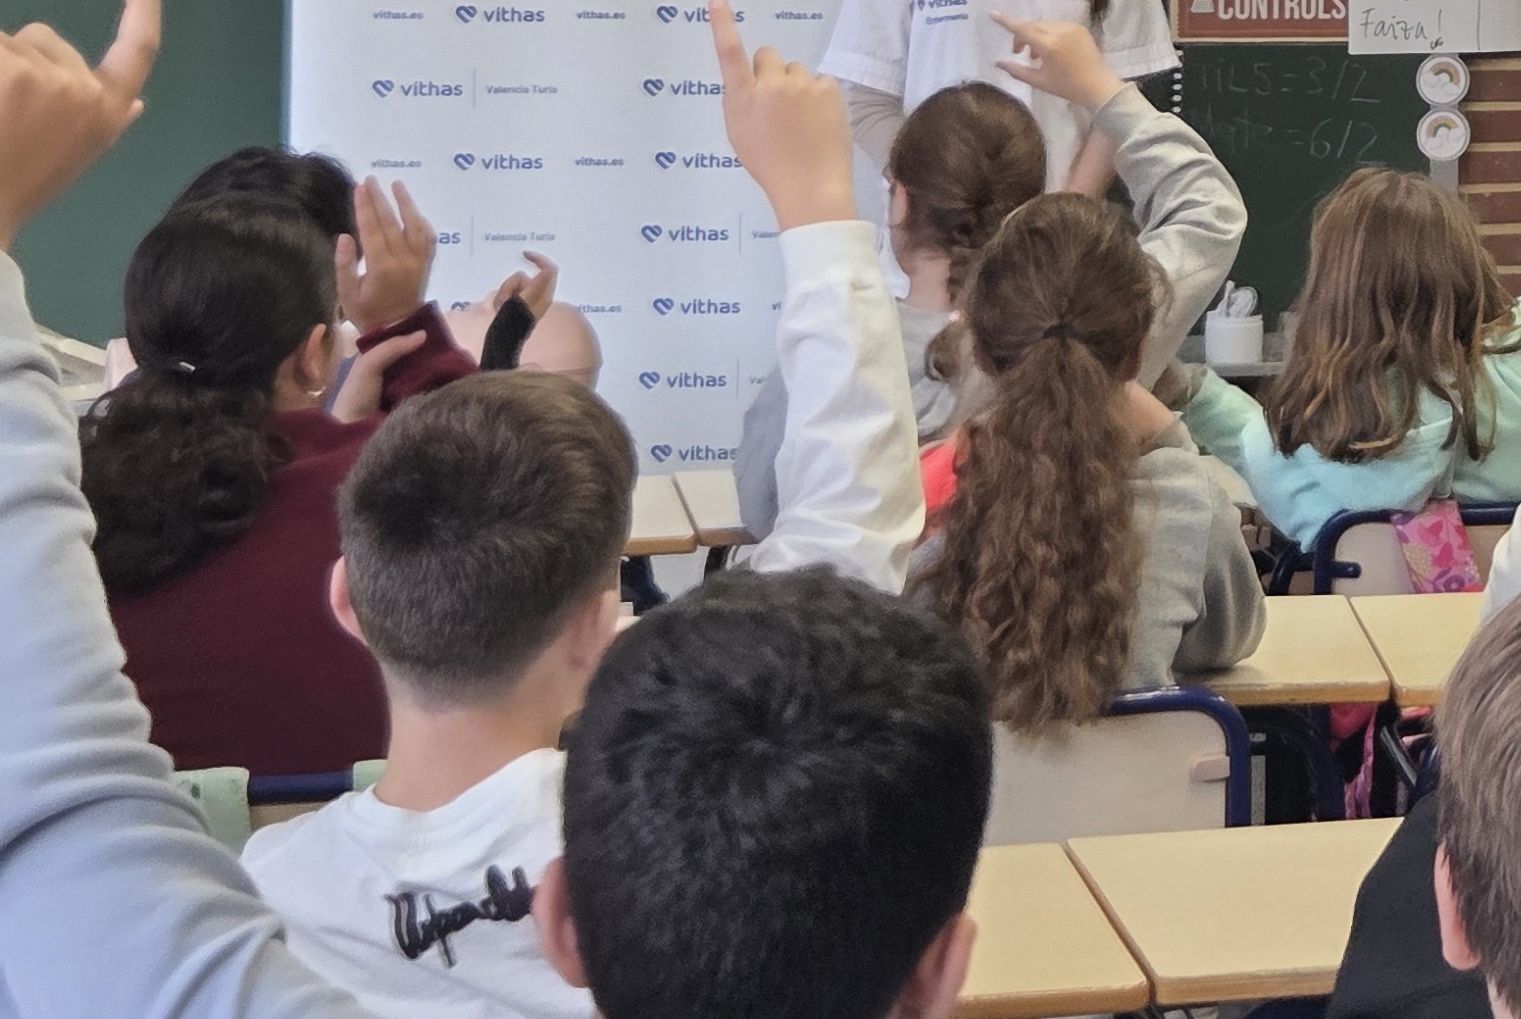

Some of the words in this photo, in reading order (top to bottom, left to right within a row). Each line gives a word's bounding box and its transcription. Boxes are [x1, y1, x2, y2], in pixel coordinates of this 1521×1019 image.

[372, 10, 425, 20] vithas.es
[483, 6, 545, 23] vithas
[576, 9, 626, 20] vithas.es
[683, 6, 745, 23] vits
[774, 10, 824, 21] vithas.es
[400, 80, 464, 97] vithas
[370, 159, 422, 169] vithas.es
[481, 153, 543, 170] vithas
[574, 156, 625, 167] vithas.es
[667, 225, 730, 242] vithas
[577, 304, 623, 314] ithas.es
[680, 298, 741, 315] vithas
[666, 372, 727, 389] vithas
